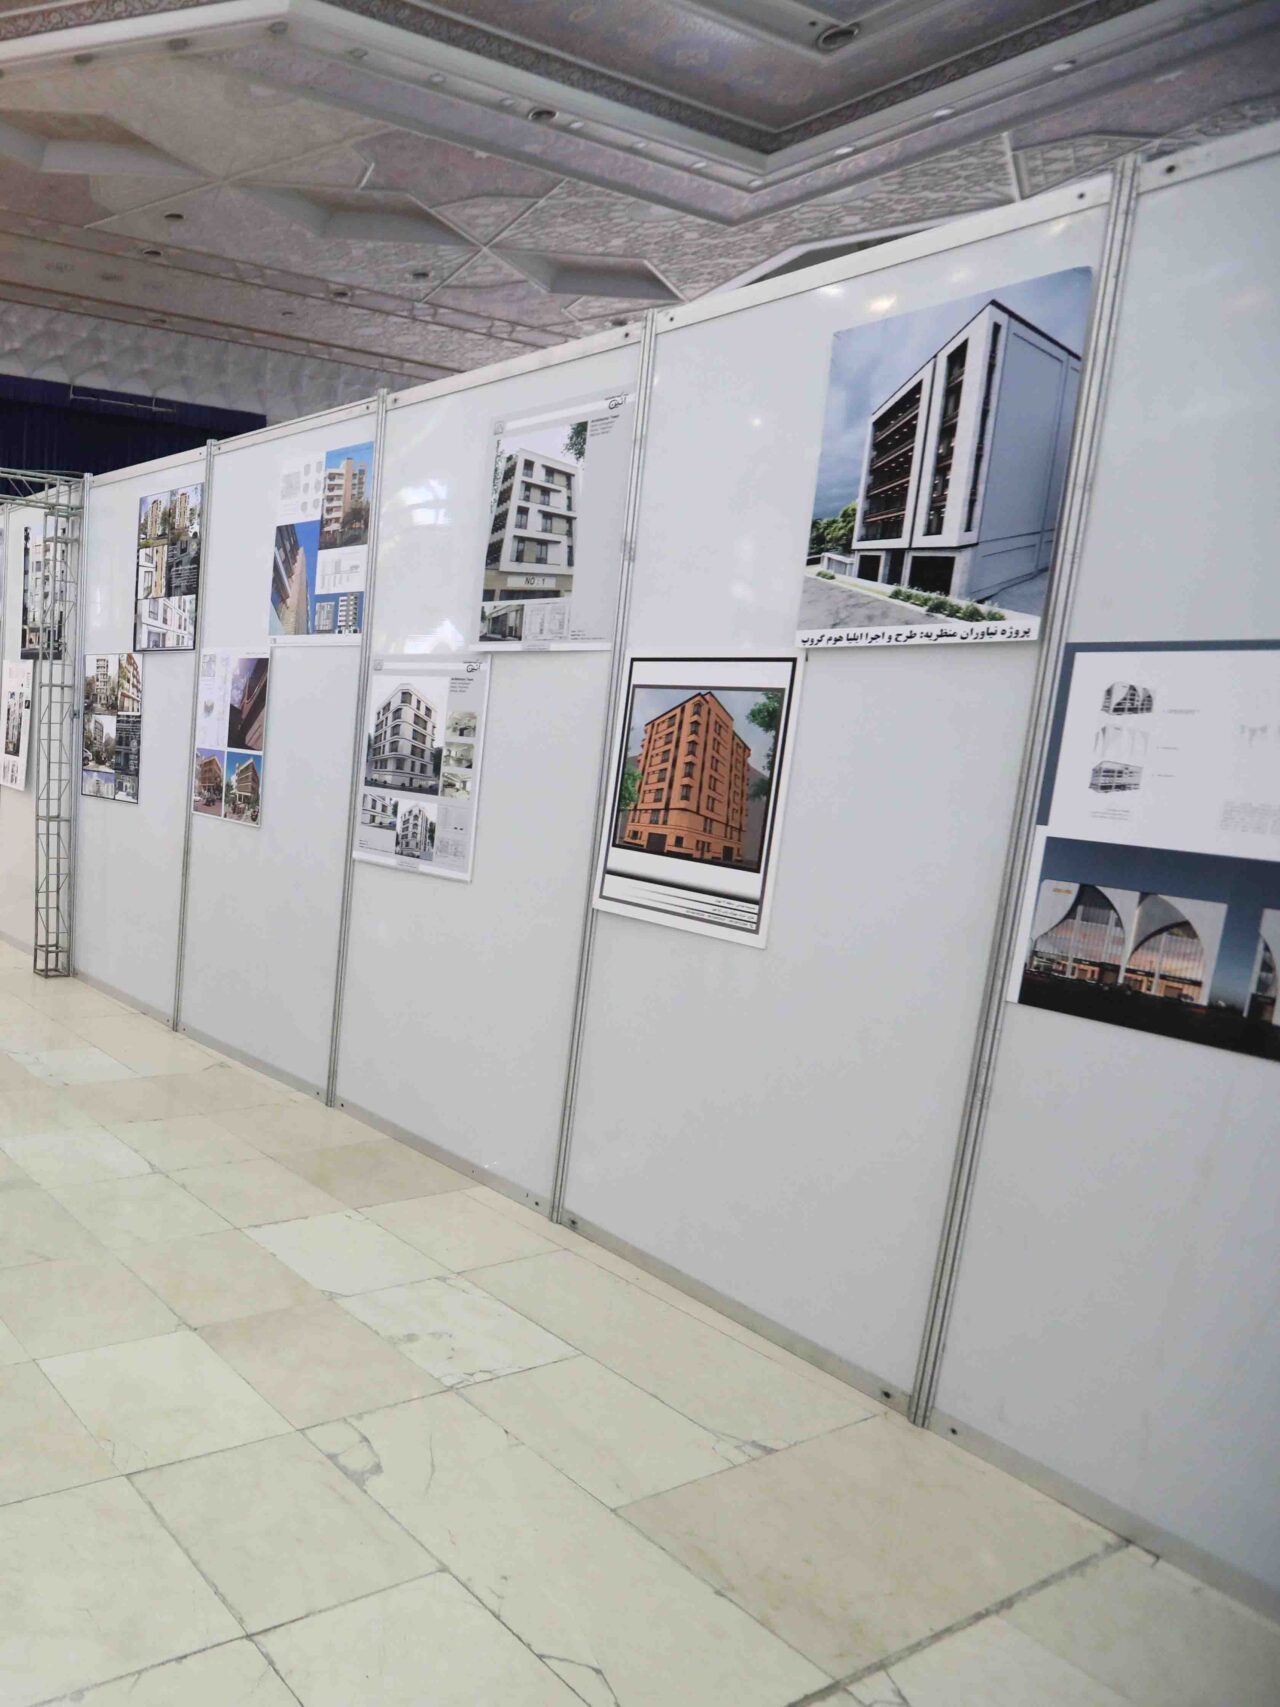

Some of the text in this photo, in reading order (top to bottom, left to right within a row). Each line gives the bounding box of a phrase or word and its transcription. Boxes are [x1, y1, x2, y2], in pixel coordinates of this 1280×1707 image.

[865, 631, 885, 644] اجرا
[886, 634, 892, 643] و
[894, 629, 917, 643] طرح
[919, 628, 958, 641] منظریه:
[960, 625, 998, 640] نیاوران
[1000, 625, 1031, 639] پروژه
[826, 634, 844, 645] هوم
